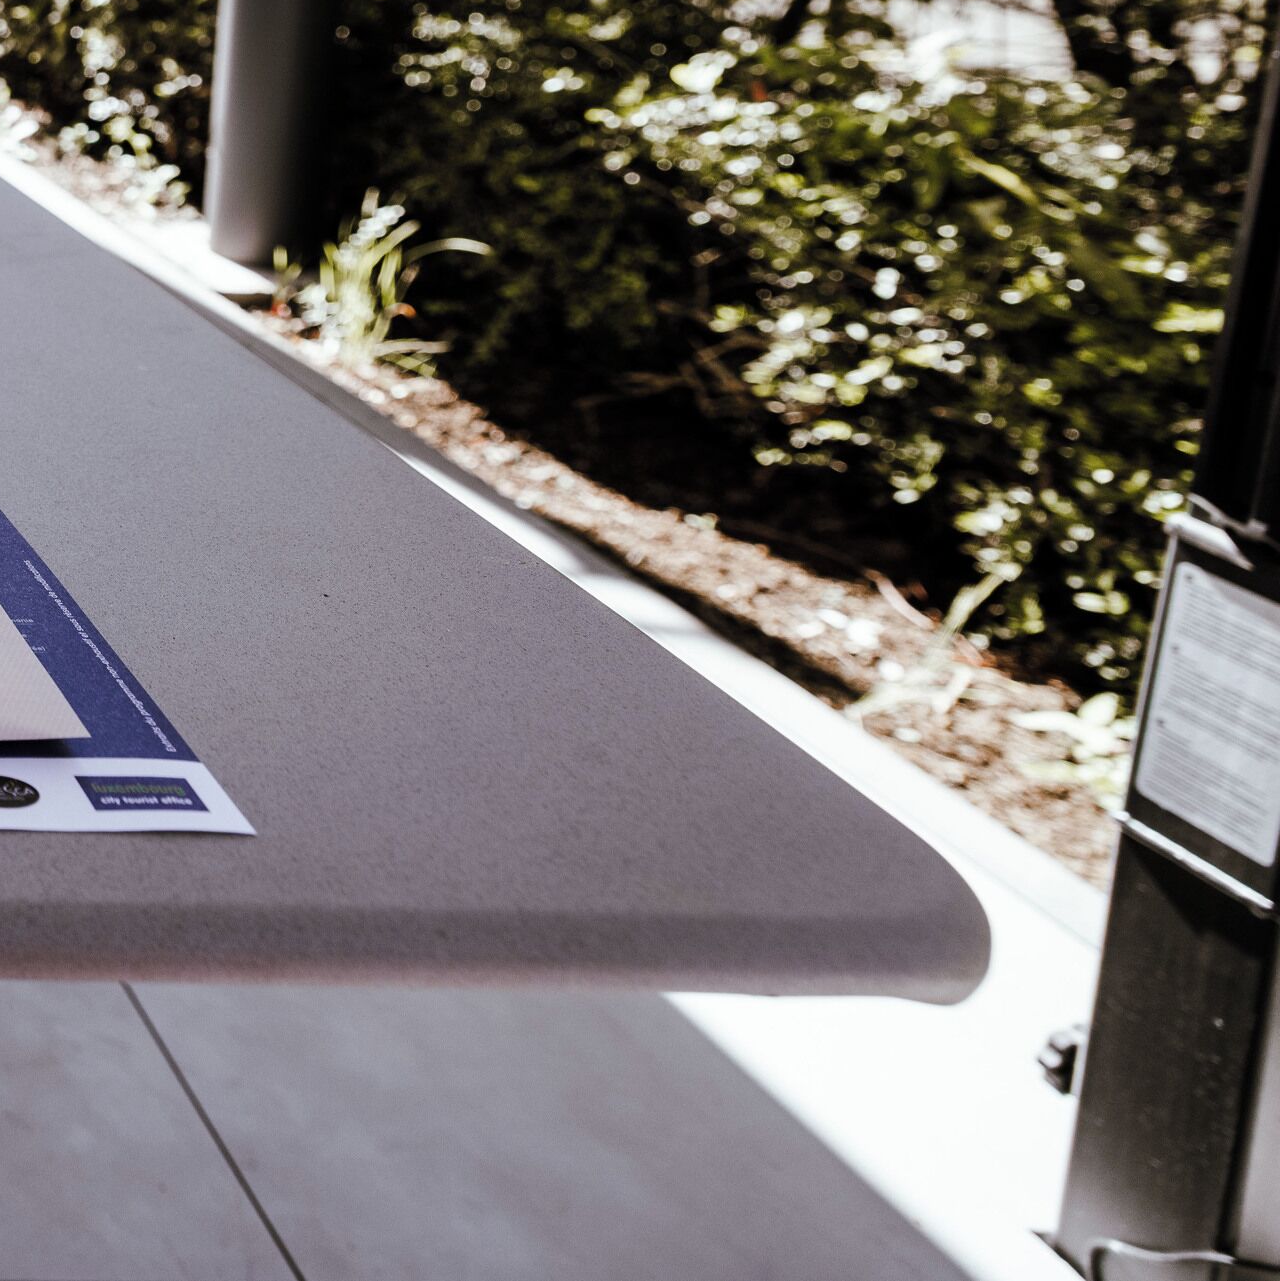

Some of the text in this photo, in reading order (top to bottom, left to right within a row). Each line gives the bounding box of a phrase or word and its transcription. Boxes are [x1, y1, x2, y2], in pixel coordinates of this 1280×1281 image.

[91, 782, 186, 796] luxembourg
[100, 795, 193, 806] city tourist office
